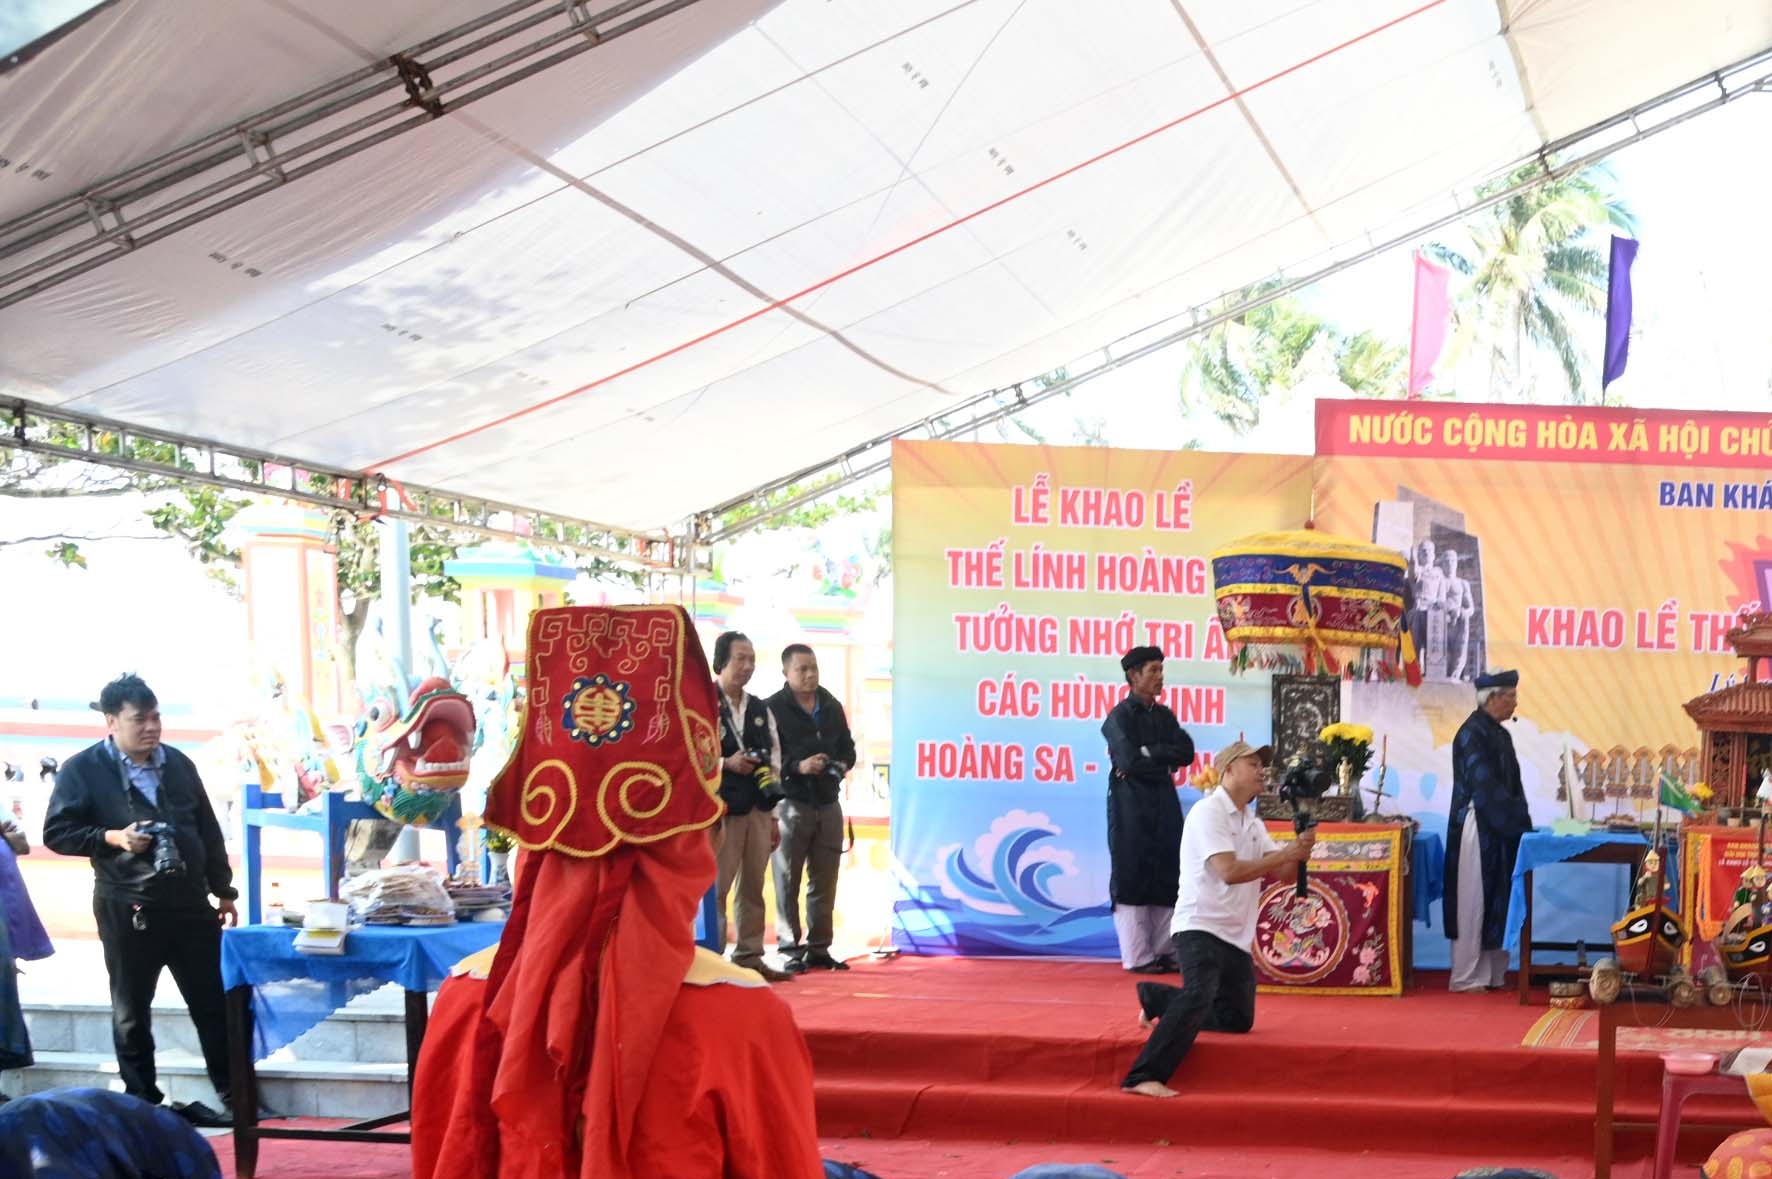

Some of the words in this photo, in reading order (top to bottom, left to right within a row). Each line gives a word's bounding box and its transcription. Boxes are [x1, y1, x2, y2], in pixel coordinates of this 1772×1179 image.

[1349, 413, 1433, 446] NƯỚC
[1443, 414, 1527, 455] CỘNG
[1537, 417, 1598, 450] HÒA
[1608, 418, 1649, 452] XÃ
[1660, 420, 1710, 460] HỘI
[1014, 475, 1049, 524] LỄ
[1060, 490, 1144, 528] KHAO
[1154, 481, 1194, 530] LỀ
[1660, 481, 1714, 508] BAN
[947, 538, 1006, 588] THẾ
[1015, 544, 1086, 591] LÍNH
[1097, 548, 1206, 595] HOÀNG
[955, 603, 1059, 653] TƯỞNG
[1070, 613, 1137, 656] NHỚ
[1145, 621, 1198, 660] TRI
[1528, 607, 1624, 648] KHAO
[1636, 600, 1678, 651] LỀ
[977, 674, 1039, 718] CÁC
[918, 734, 1025, 782] HOÀNG
[1034, 745, 1075, 782] SA
